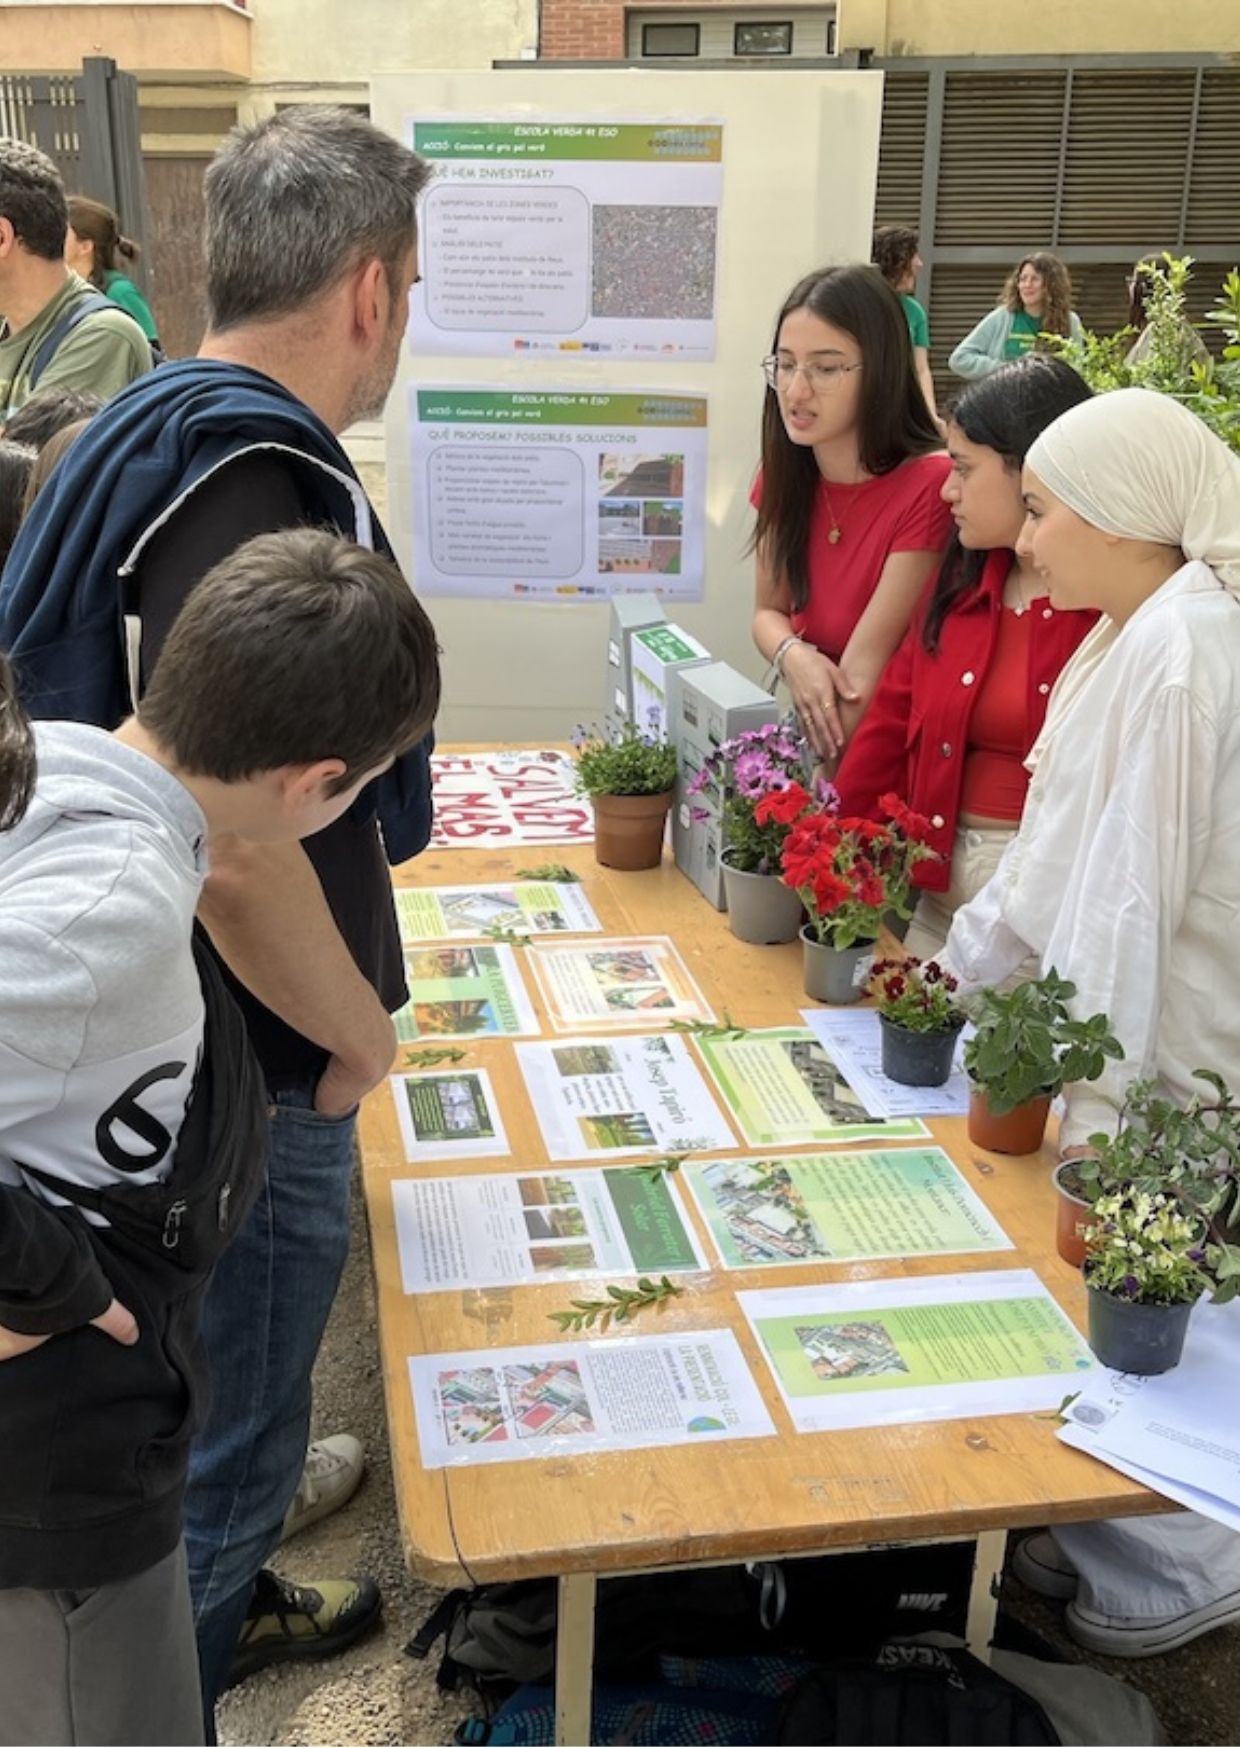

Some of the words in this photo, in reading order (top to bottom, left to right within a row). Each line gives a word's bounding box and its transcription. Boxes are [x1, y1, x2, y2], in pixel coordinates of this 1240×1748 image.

[514, 127, 550, 137] ESCOLA
[552, 128, 583, 137] VERDA
[598, 127, 619, 138] ESO
[452, 168, 476, 178] HEM
[512, 394, 546, 404] ESCOLA
[590, 396, 611, 406] ESO
[454, 431, 512, 442] PROPOSEM?
[516, 432, 573, 442] POSSIBLES
[576, 433, 637, 444] SOLUCIONS
[431, 759, 477, 784] EL
[487, 765, 596, 840] SALVEM
[644, 1059, 669, 1088] Josep
